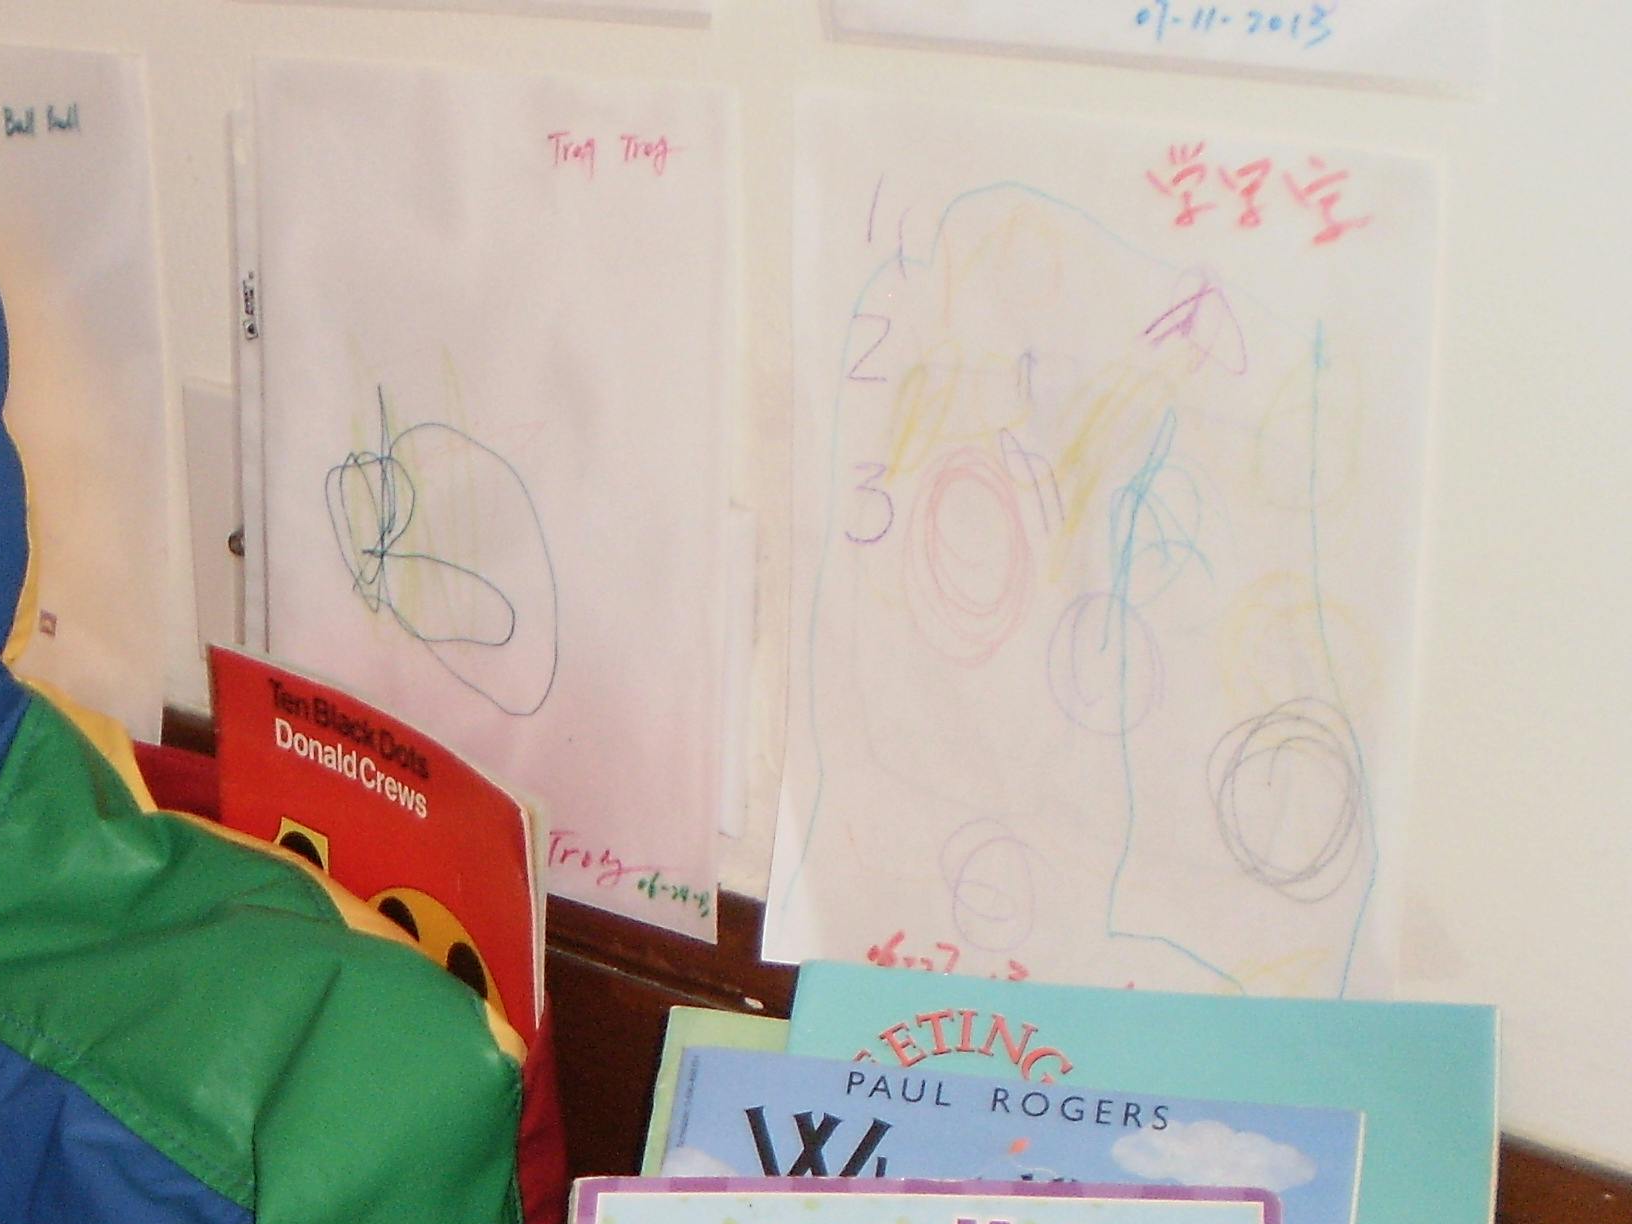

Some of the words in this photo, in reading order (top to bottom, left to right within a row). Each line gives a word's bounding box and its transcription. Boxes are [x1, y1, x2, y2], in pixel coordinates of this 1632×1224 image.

[275, 717, 357, 780] Donald
[359, 756, 428, 819] Crews
[846, 1071, 951, 1107] PAUL
[991, 1087, 1169, 1131] ROGERS
